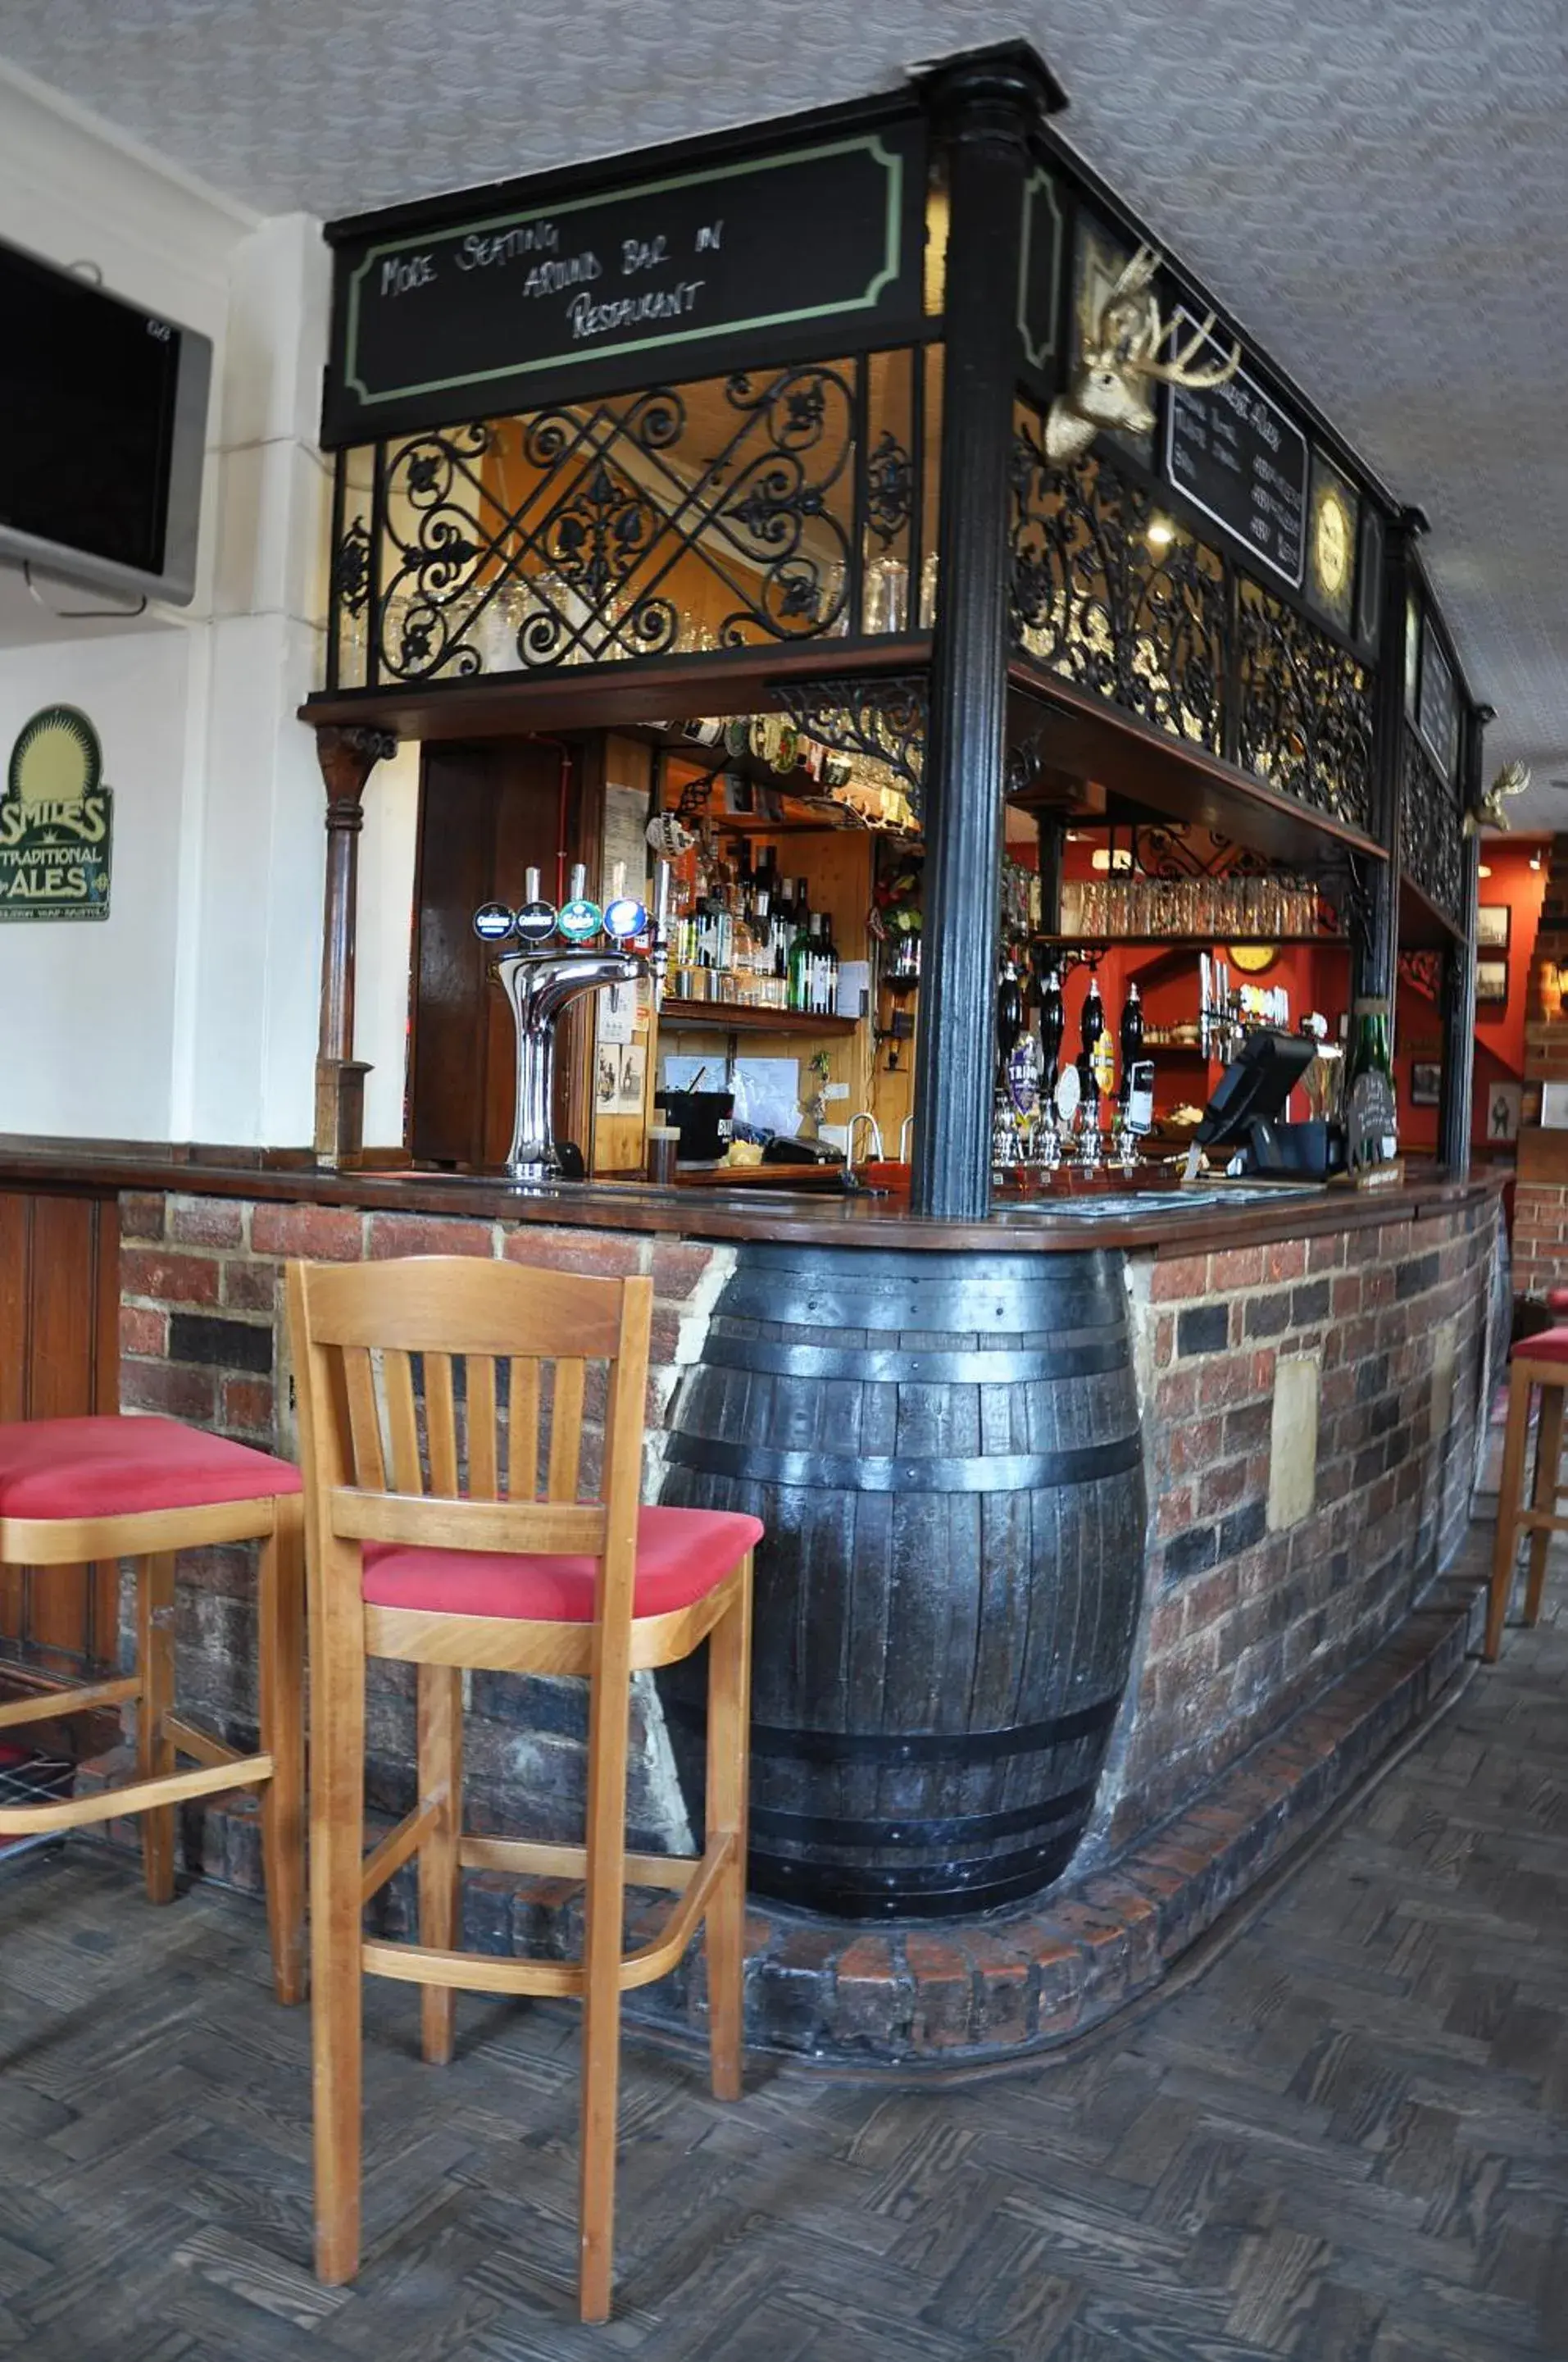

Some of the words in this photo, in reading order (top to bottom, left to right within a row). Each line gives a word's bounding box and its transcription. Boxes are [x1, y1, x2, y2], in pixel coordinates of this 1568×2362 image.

[380, 253, 439, 297] MORE
[453, 221, 560, 271] SEATING
[522, 251, 603, 298] AROUND
[620, 234, 671, 275] BAR
[693, 220, 725, 252] IN
[0, 847, 102, 866] TRADITIONAL
[7, 867, 88, 898] ALES
